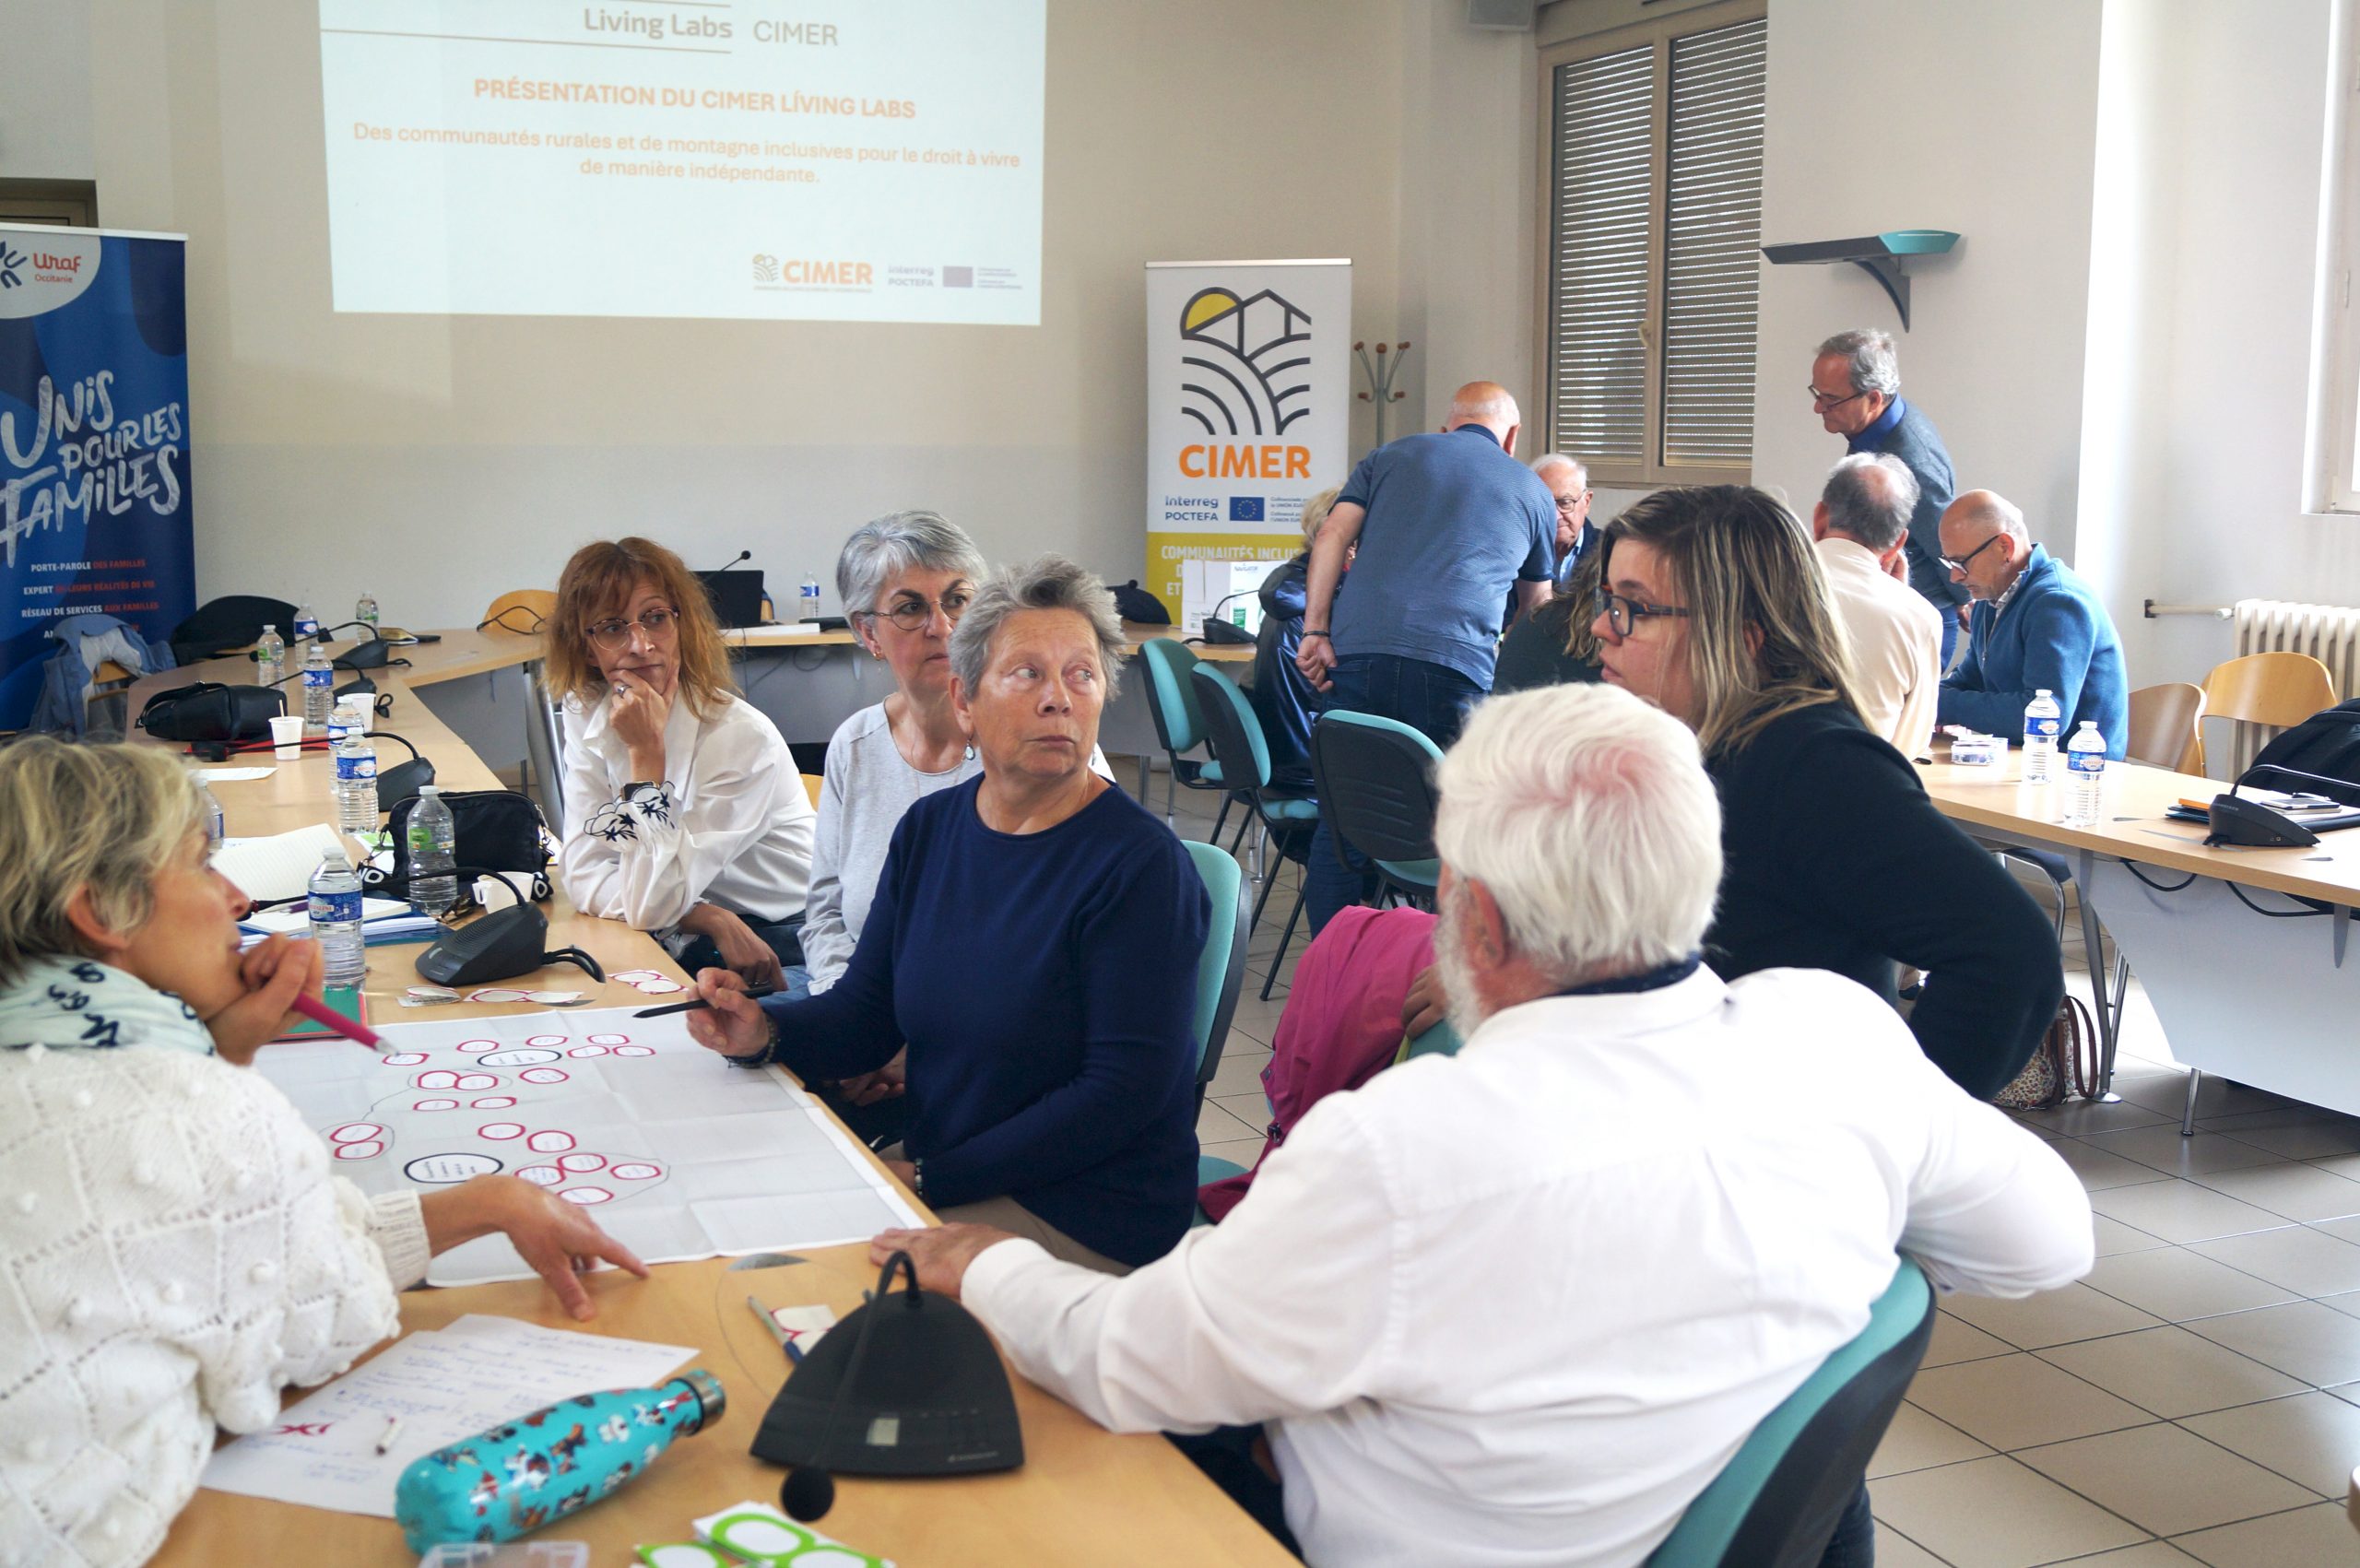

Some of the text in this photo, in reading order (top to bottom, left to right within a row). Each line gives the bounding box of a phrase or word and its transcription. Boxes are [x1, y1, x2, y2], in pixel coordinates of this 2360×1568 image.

[583, 8, 733, 40] Living Labs
[752, 19, 839, 46] CIMER
[474, 76, 655, 107] PRÉSENTATION
[661, 88, 695, 108] DU
[702, 90, 775, 112] CIMER
[861, 99, 916, 119] LABS
[353, 123, 1021, 168] Des communautés rurales et de montagne inclusives pour le droit à vivre
[580, 159, 820, 183] de manière indépendante.
[33, 253, 82, 274] Uraf
[783, 259, 873, 285] CIMER
[34, 274, 74, 283] Occitanie
[888, 277, 935, 288] POCTEFA
[143, 402, 182, 446] LES
[1179, 444, 1312, 479] CIMER
[1164, 495, 1219, 508] Interreg
[1164, 512, 1219, 522] POCTEFA
[1161, 545, 1300, 560] COMMUNAUTÉS INCLUS
[30, 560, 91, 572] PORTE-PAROLE
[110, 559, 146, 570] FAMILLES
[23, 585, 53, 595] EXPERT
[1166, 583, 1181, 596] ET
[21, 607, 53, 618] RÉSEAU
[53, 606, 65, 616] DE
[66, 604, 102, 615] SERVICES
[123, 601, 159, 611] FAMILLES
